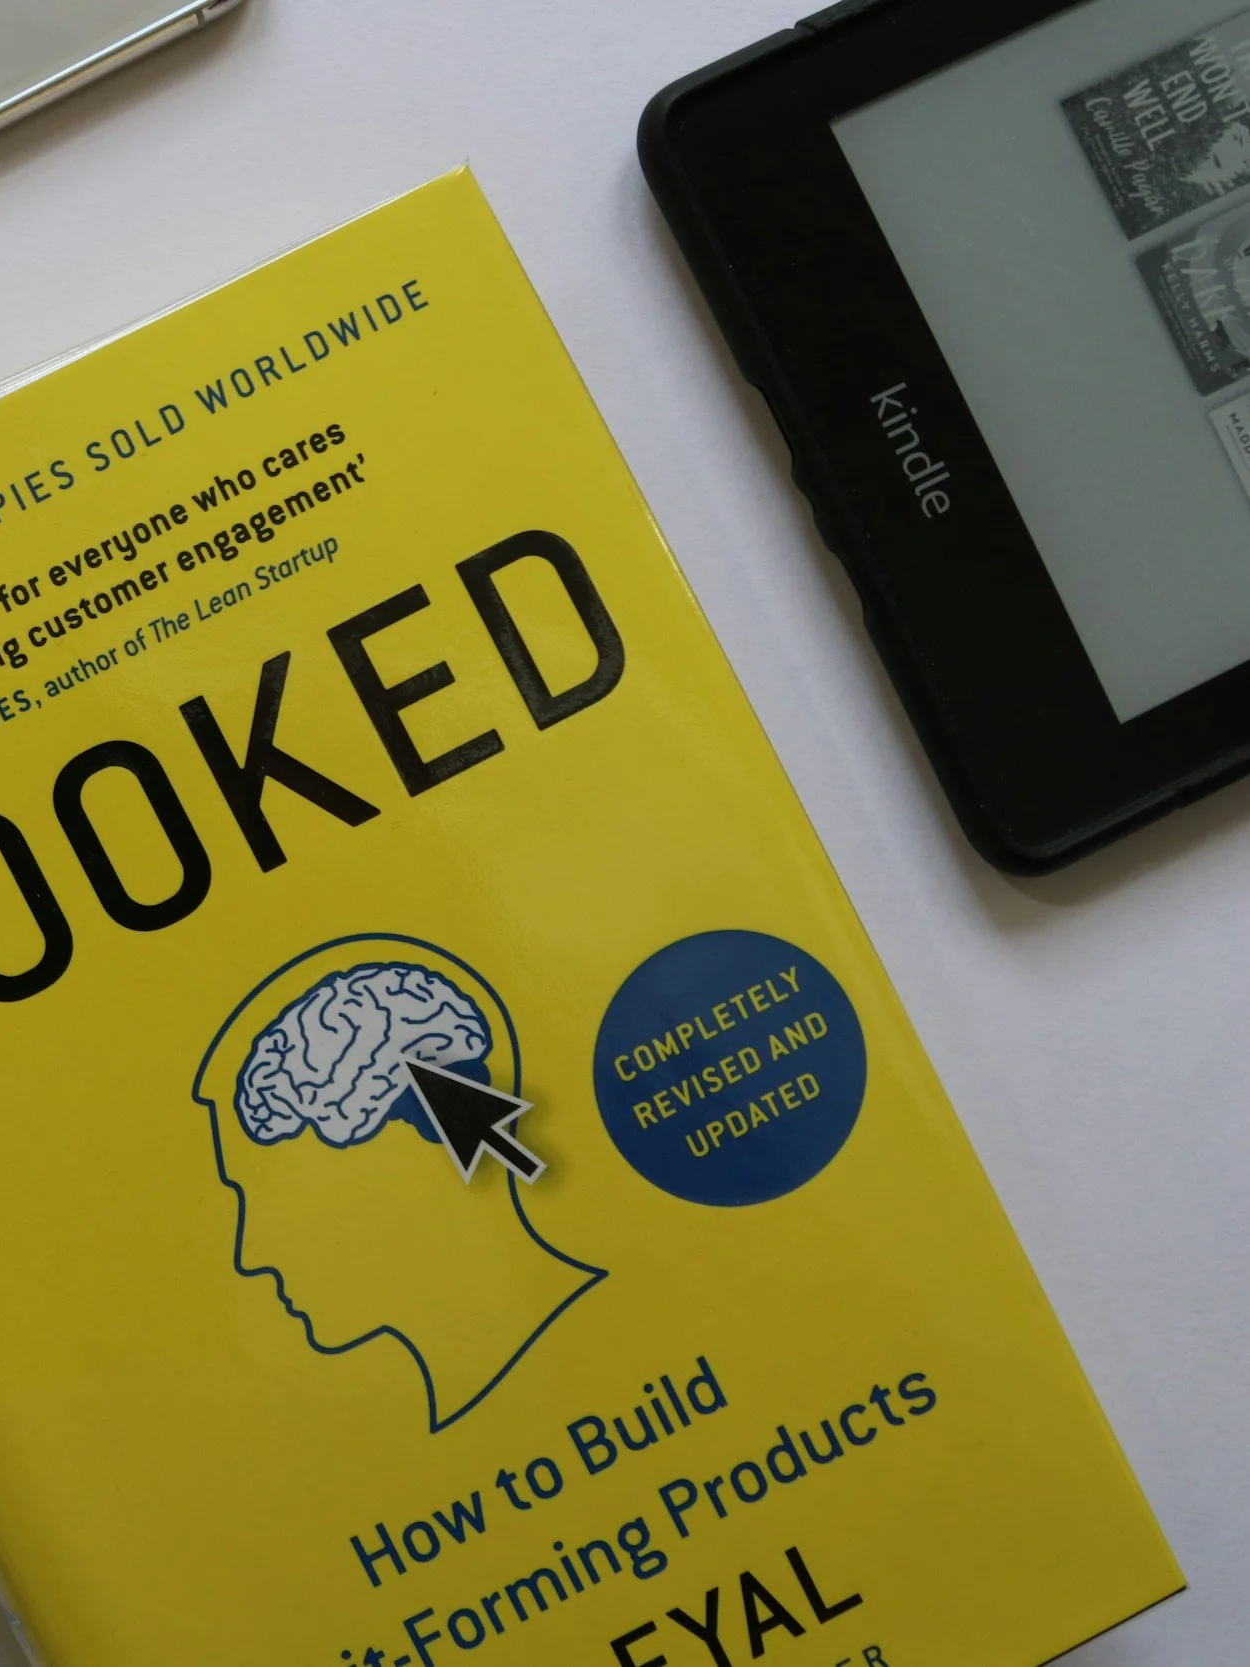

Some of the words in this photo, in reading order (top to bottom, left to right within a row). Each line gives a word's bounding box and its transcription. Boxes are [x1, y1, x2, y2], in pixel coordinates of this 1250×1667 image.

[1085, 96, 1135, 157] Camille
[1123, 78, 1177, 152] WELL
[1160, 70, 1208, 123] END
[85, 403, 186, 472] SOLD
[194, 279, 430, 415] WORLDWIDE
[1160, 262, 1191, 310] KELLY
[1188, 317, 1222, 373] HARMS
[48, 503, 189, 587] everyone
[190, 469, 257, 513] who
[262, 423, 346, 478] cares
[870, 381, 951, 519] kindle
[27, 561, 169, 648] customer
[44, 647, 119, 698] author
[123, 627, 147, 657] of
[147, 612, 191, 643] The
[193, 581, 253, 622] Lean
[254, 537, 339, 591] Startup
[613, 965, 801, 1082] COMPLETELY
[632, 1046, 762, 1129] REVISED
[768, 1011, 829, 1061] AND
[685, 1072, 822, 1158] UPDATED
[340, 1515, 669, 1667] -Forming
[657, 1371, 937, 1539] Products
[349, 1490, 487, 1589] How
[494, 1456, 564, 1511] to
[566, 1355, 729, 1476] Build
